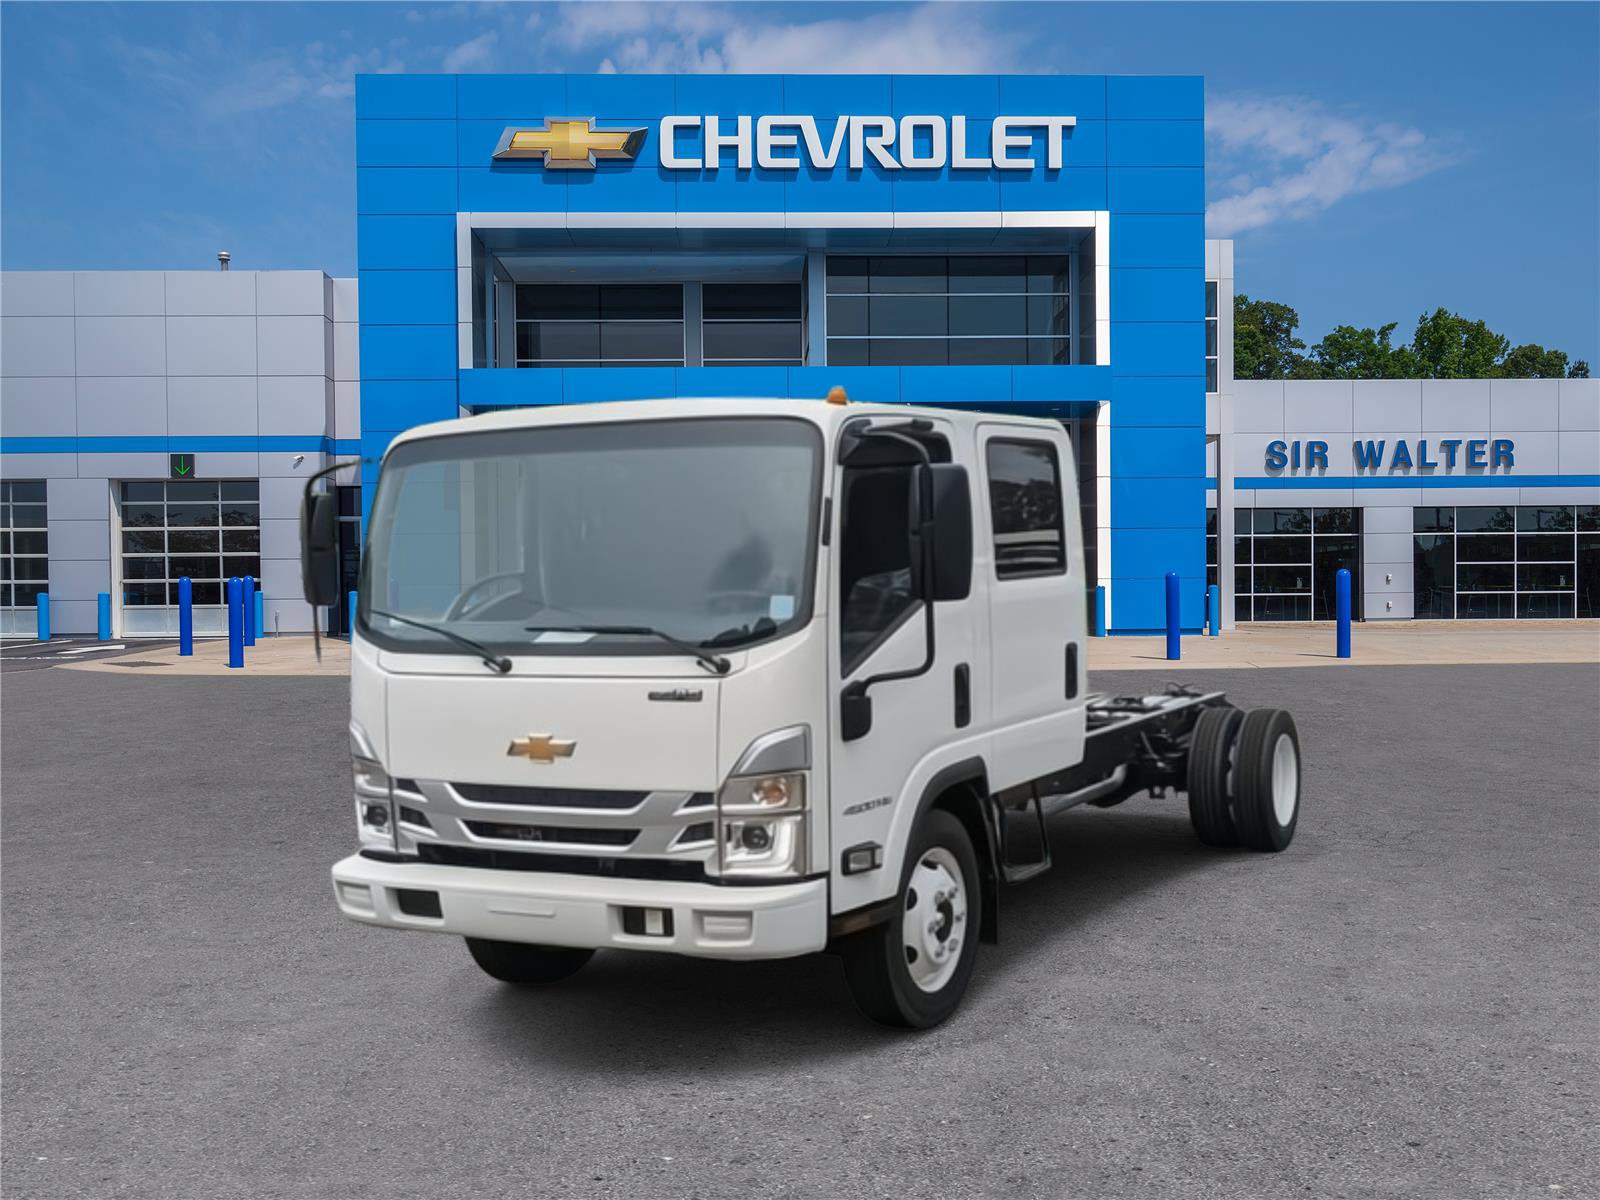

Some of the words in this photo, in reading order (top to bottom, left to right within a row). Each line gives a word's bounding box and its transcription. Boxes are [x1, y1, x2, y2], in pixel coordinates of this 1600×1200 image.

[659, 115, 1077, 169] CHEVROLET
[1265, 440, 1329, 470] SIR
[1353, 439, 1516, 469] WALTER
